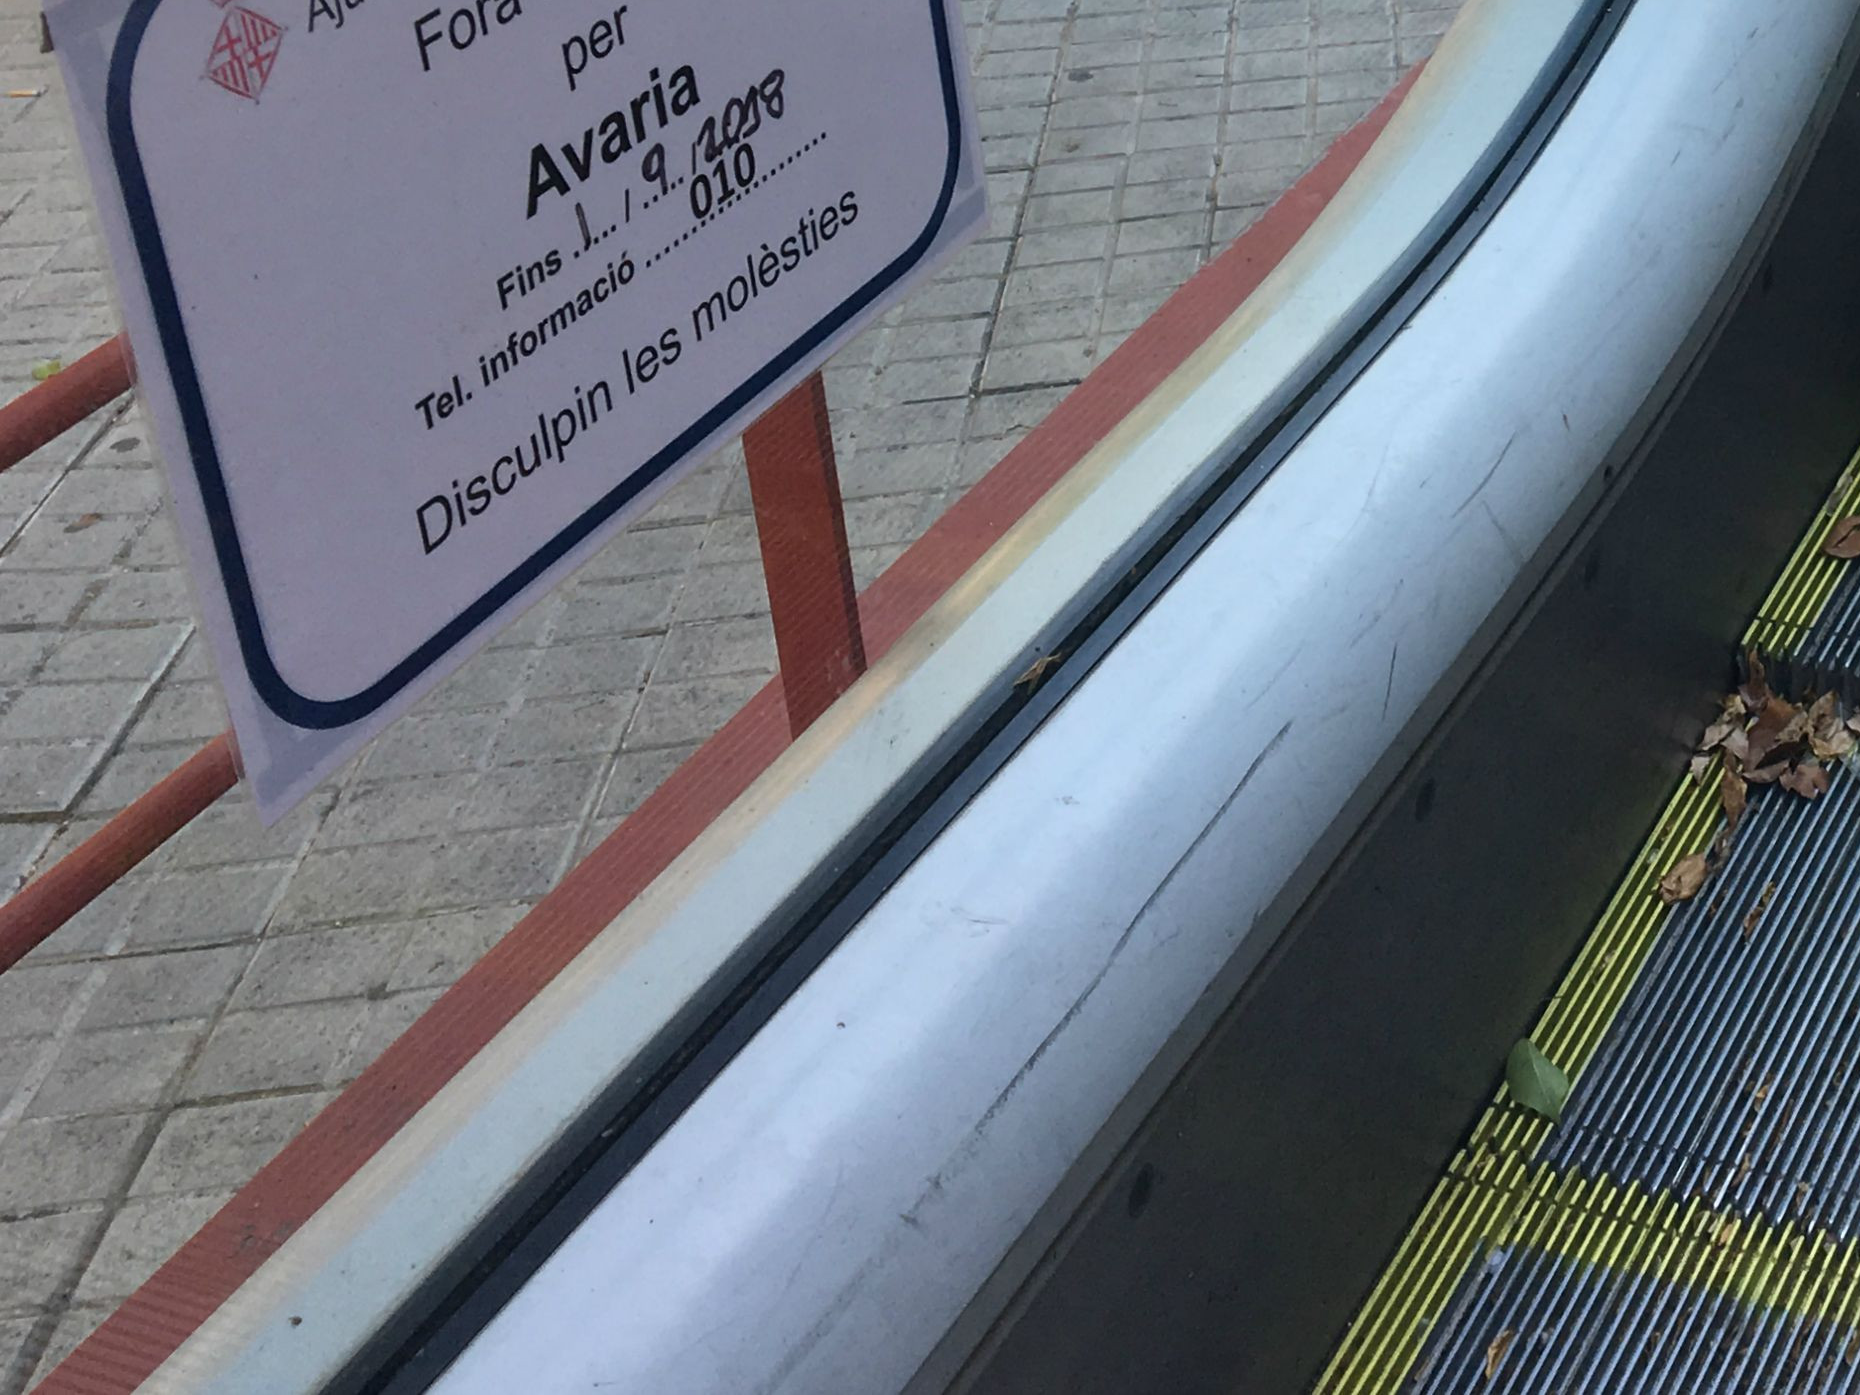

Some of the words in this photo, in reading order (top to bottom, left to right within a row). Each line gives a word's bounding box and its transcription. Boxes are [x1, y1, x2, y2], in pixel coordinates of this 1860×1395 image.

[561, 5, 628, 91] per
[526, 65, 700, 220] Avaria
[415, 376, 473, 431] Tel.
[479, 251, 635, 388] informació
[690, 143, 756, 219] 010
[496, 249, 562, 311] Fins
[415, 380, 614, 556] Disculpin
[622, 328, 682, 394] les
[692, 190, 859, 341] molèsties
